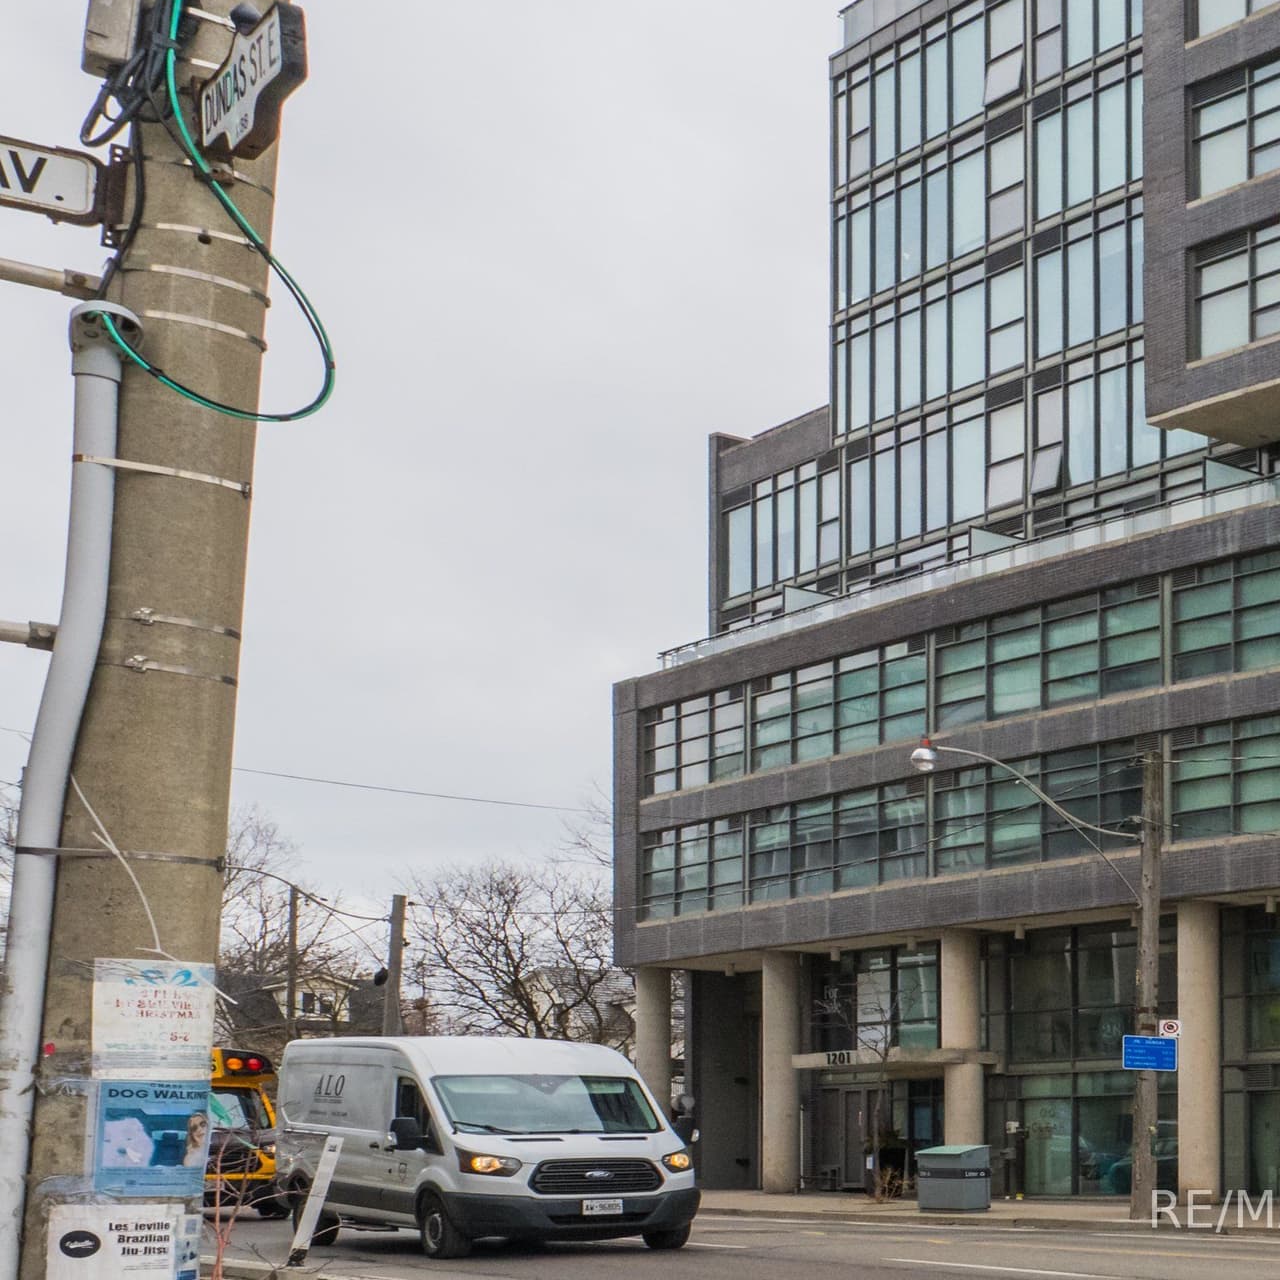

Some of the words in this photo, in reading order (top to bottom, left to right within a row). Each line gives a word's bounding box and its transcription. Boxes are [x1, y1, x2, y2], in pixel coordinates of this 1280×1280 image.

[205, 54, 247, 135] DUNDAS
[826, 1052, 851, 1065] 1201
[108, 1089, 149, 1099] DOG
[108, 1222, 170, 1232] Lesieville
[117, 1234, 170, 1244] Brazilian
[120, 1246, 169, 1255] Jiu-Jitsu
